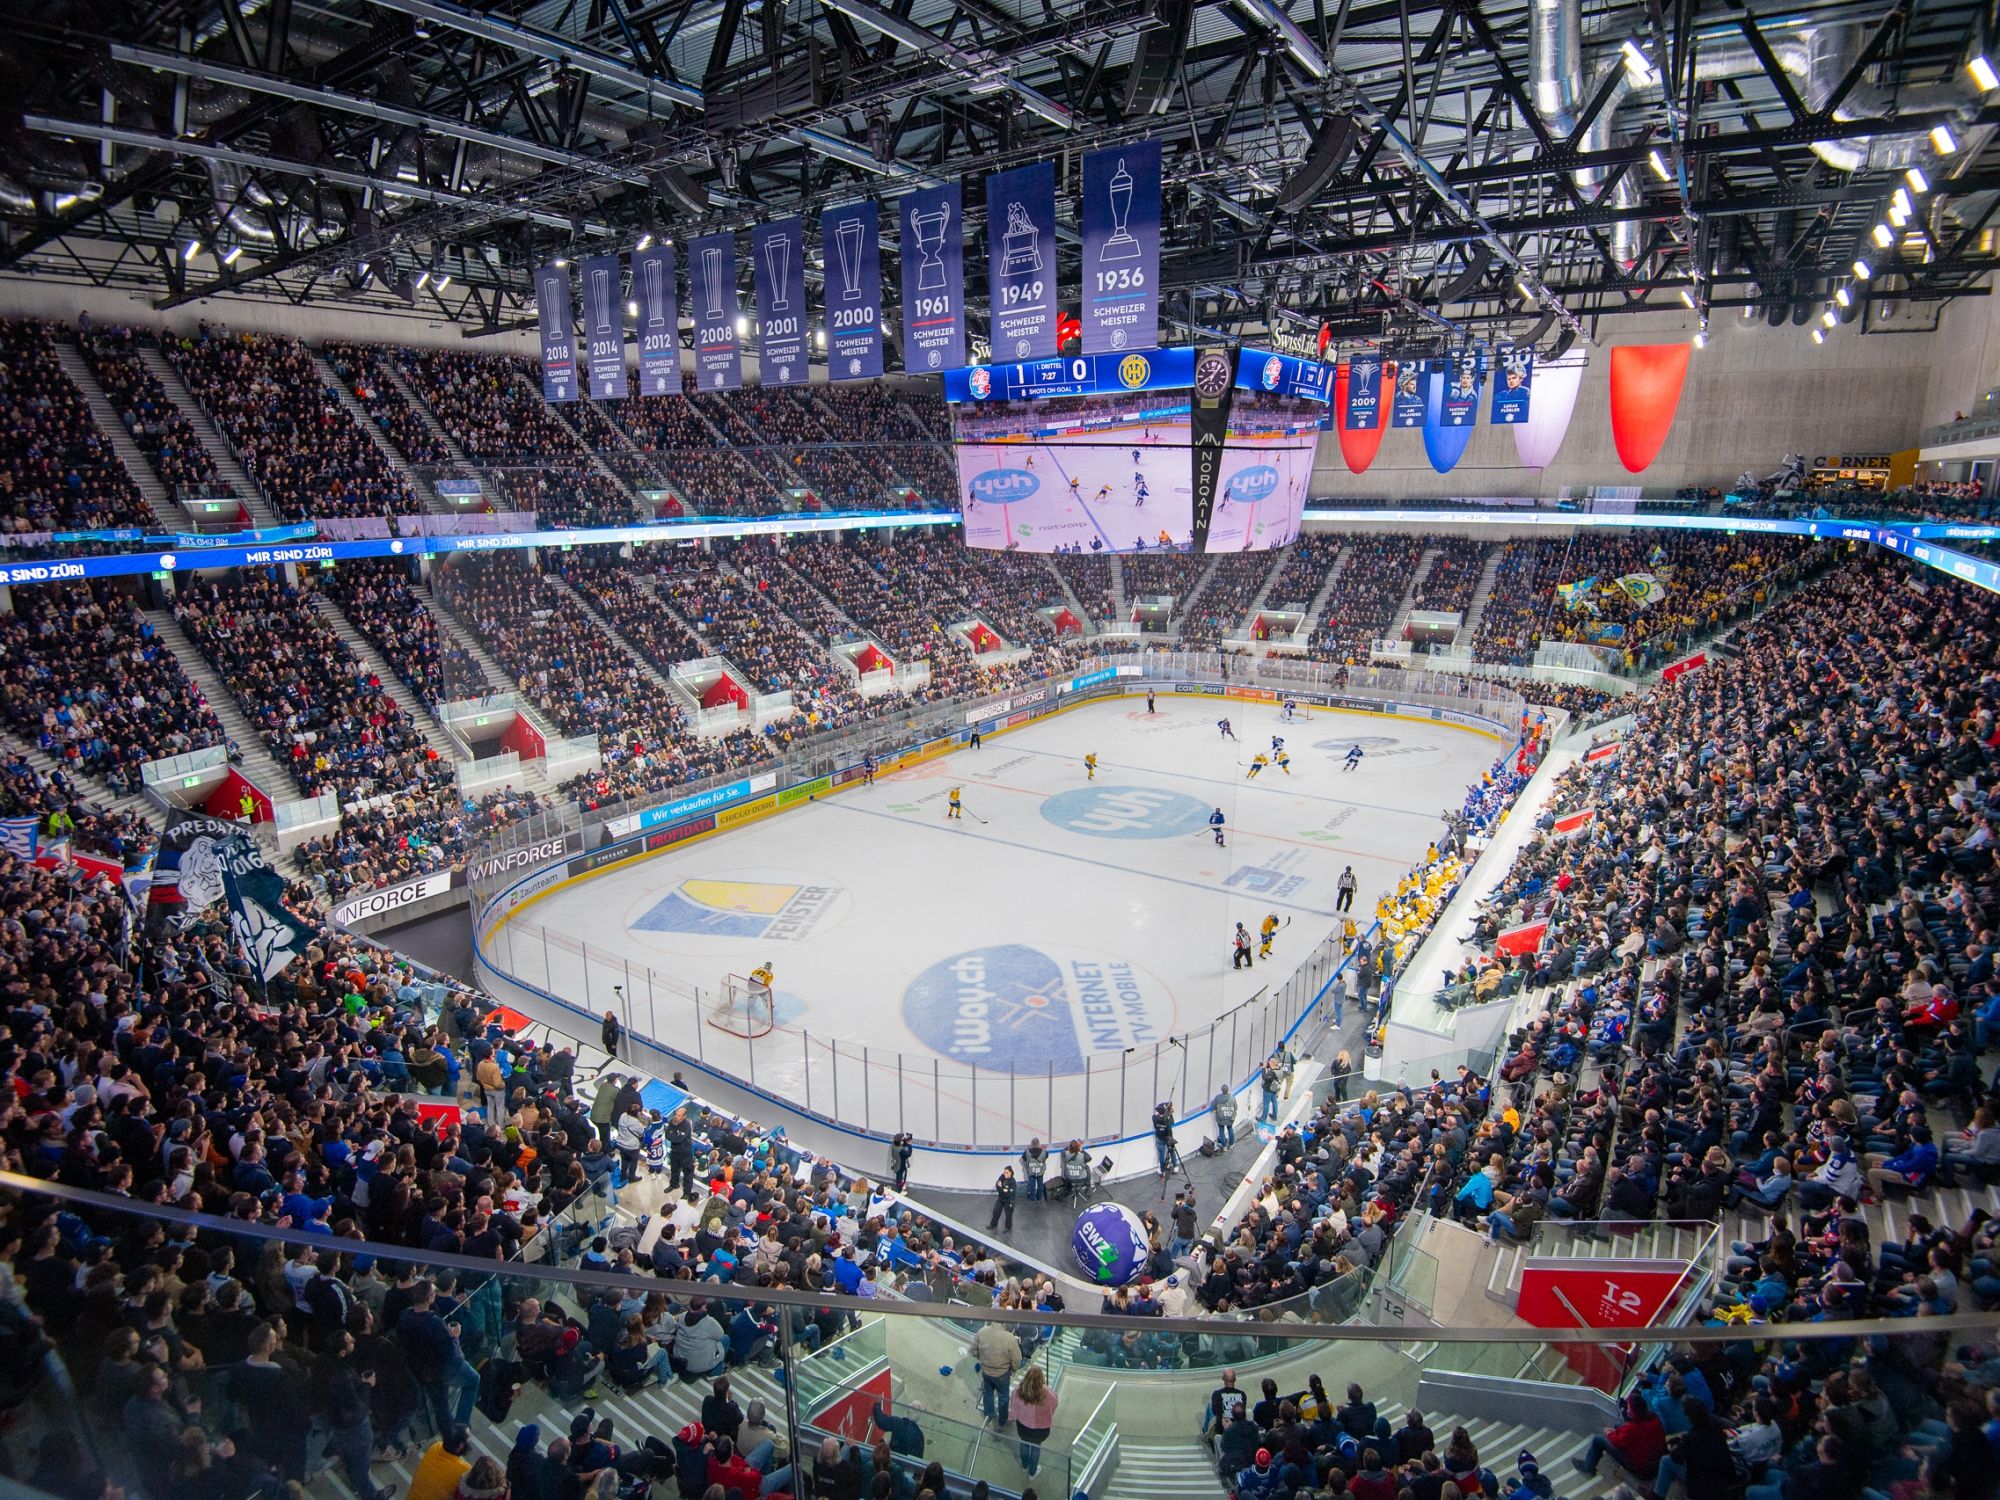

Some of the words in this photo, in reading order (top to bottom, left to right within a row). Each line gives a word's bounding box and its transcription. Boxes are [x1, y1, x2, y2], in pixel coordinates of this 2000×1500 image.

[1096, 267, 1145, 292] 1936
[1001, 281, 1044, 305] 1949
[915, 296, 949, 318] 1961
[1093, 303, 1146, 317] SCHWEIZER
[834, 307, 873, 328] 2000
[1000, 315, 1046, 329] SCHWEIZER
[1100, 315, 1138, 327] MEISTER
[700, 325, 733, 343] 2008
[766, 318, 798, 336] 2001
[913, 327, 955, 340] SCHWEIZER
[1006, 326, 1039, 338] MEISTER
[592, 340, 618, 356] 2014
[644, 334, 671, 350] 2012
[835, 337, 874, 349] SCHWEIZER
[919, 337, 949, 348] MEISTER
[546, 346, 568, 361] 2018
[702, 353, 733, 363] SCHWEIZER
[766, 345, 800, 356] SCHWEIZER
[841, 345, 869, 356] MEISTER
[645, 359, 674, 369] SCHWEIZER
[707, 361, 730, 370] MEISTER
[771, 354, 796, 364] MEISTER
[547, 368, 571, 377] SCHWEIZER
[594, 364, 620, 374] SCHWEIZER
[598, 372, 617, 380] MEISTER
[650, 366, 671, 375] MEISTER
[1016, 364, 1024, 385] 1
[1072, 359, 1087, 380] 0
[551, 376, 569, 384] MEISTER
[1352, 397, 1376, 407] 2009
[1197, 452, 1213, 529] NORQAIN
[457, 539, 474, 549] MIR
[476, 538, 500, 548] SIND
[501, 535, 522, 547] ZÜRI
[246, 551, 271, 563] MIR
[273, 549, 302, 561] SIND
[303, 546, 333, 559] ZÜRI
[11, 567, 49, 583] SIND
[50, 563, 85, 578] ZÜRI
[1013, 691, 1047, 708] WINFORCE
[970, 702, 1006, 722] WINFORCE
[653, 809, 668, 821] Wir
[670, 797, 712, 815] verkaufen
[713, 791, 725, 802] für
[726, 787, 741, 798] Sie.
[720, 809, 750, 824] CHICCO
[649, 818, 713, 848] PROFIDATA
[472, 839, 563, 881] WINFORCE
[519, 873, 558, 899] Zaunteam
[763, 886, 832, 940] FENSTER
[1071, 960, 1124, 1050] INTERNET
[651, 1146, 663, 1158] 30
[1082, 1221, 1111, 1256] ewz
